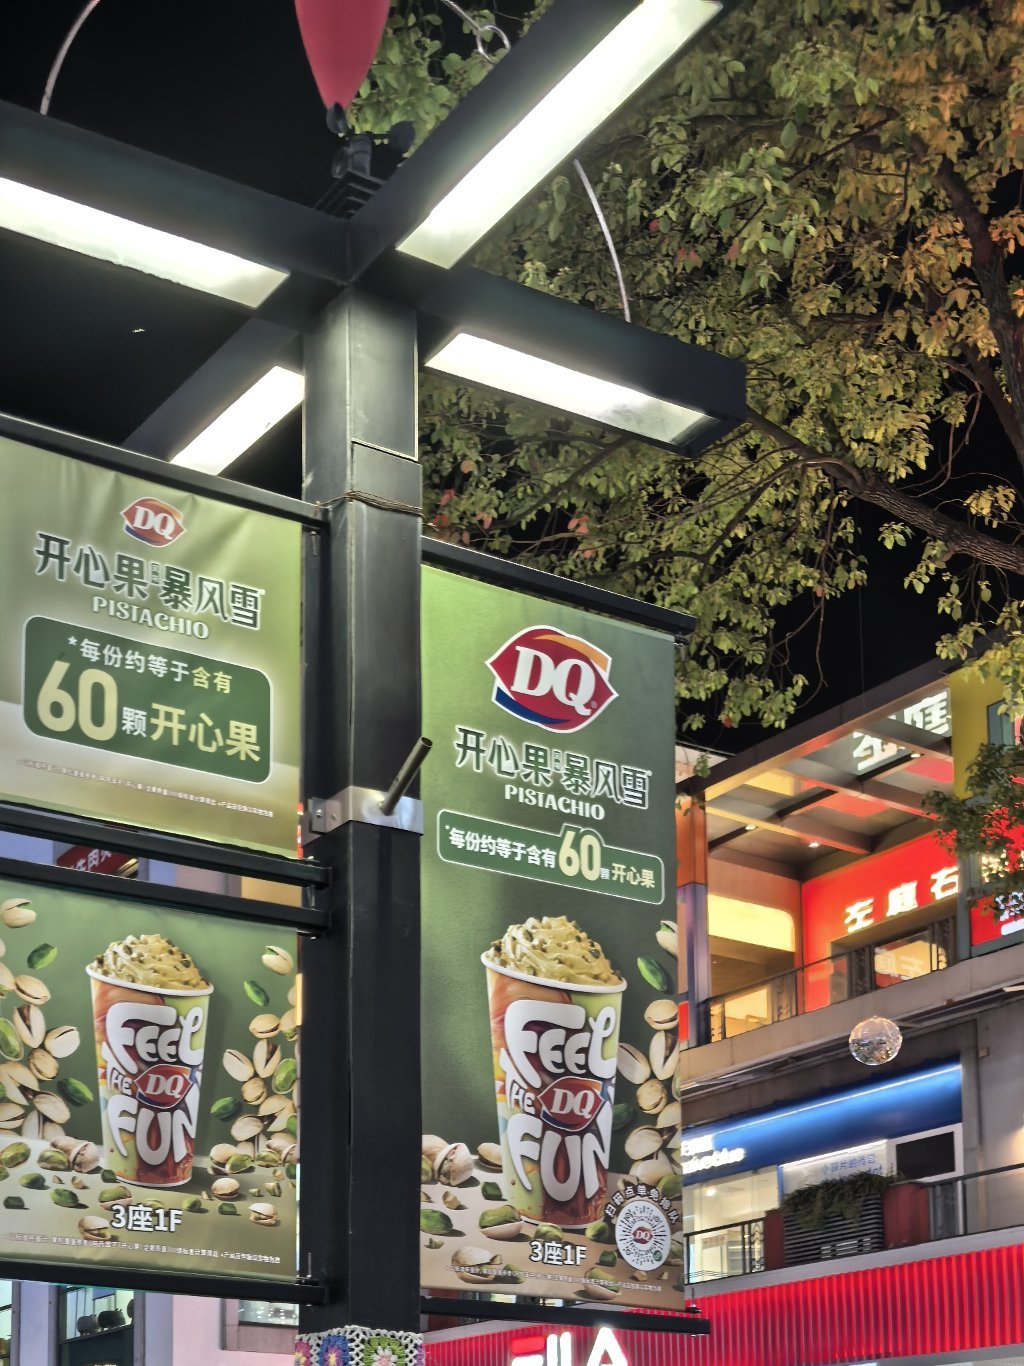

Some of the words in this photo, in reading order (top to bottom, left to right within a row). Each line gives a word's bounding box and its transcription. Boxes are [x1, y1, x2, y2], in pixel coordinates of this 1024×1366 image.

[131, 504, 177, 541] DQ
[92, 596, 210, 640] PISTACHIO
[510, 644, 598, 716] DQ
[504, 784, 606, 821] PISTACHIO
[104, 1002, 205, 1075] FEEL
[504, 999, 617, 1089] FEEL
[144, 1072, 188, 1100] DQ
[550, 1086, 597, 1118] DQ
[107, 1085, 200, 1166] FUN
[507, 1098, 615, 1202] FUN
[111, 1203, 183, 1233] 3座1F
[530, 1240, 588, 1266] 3座1F
